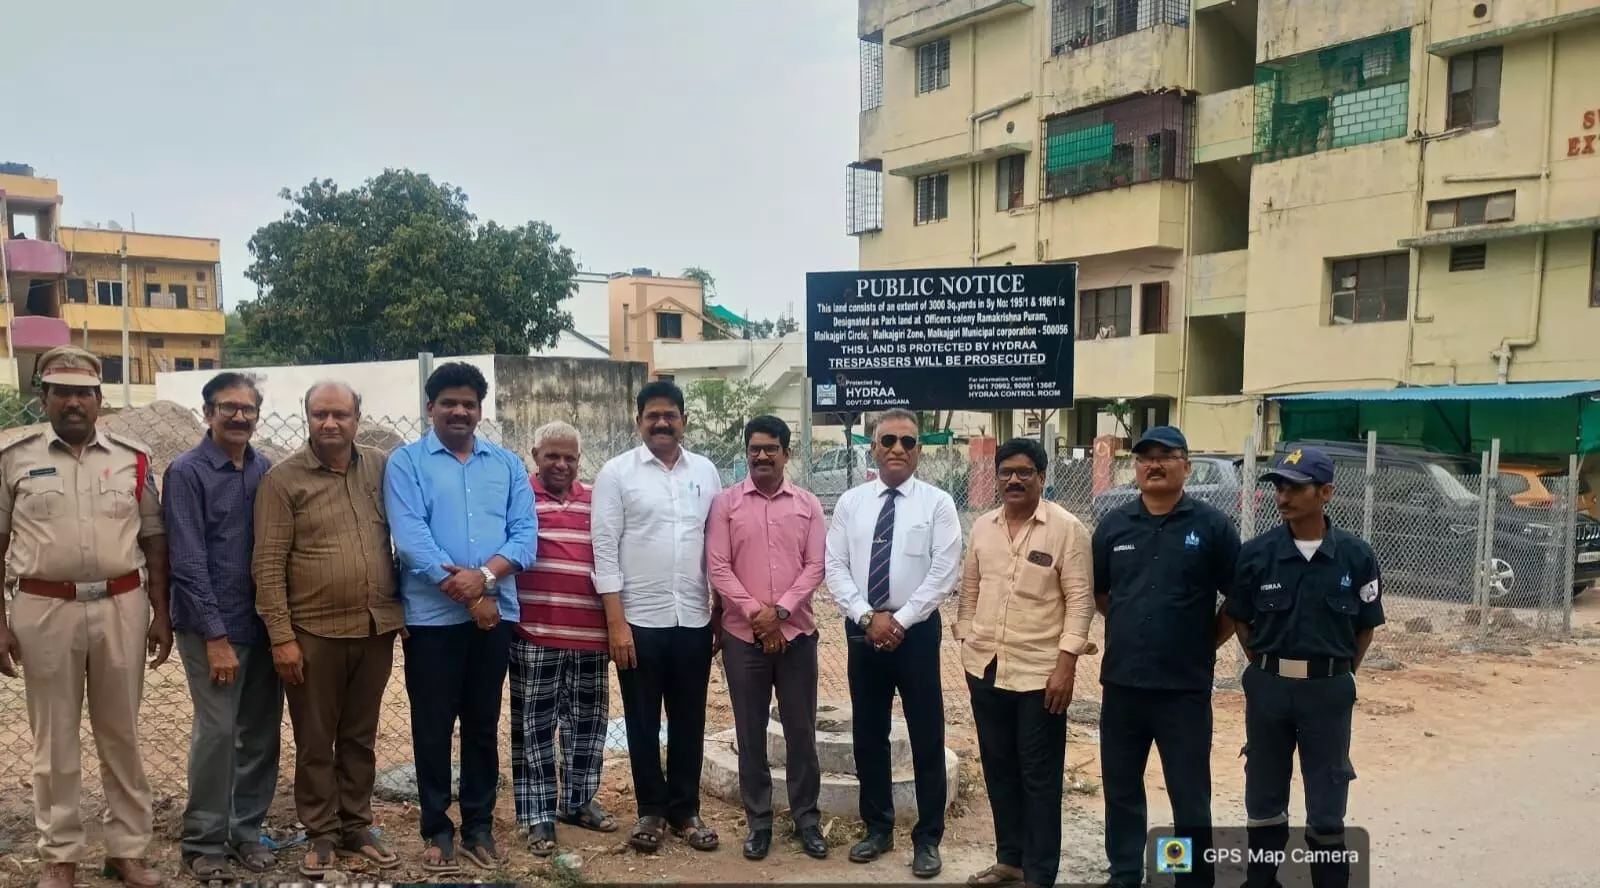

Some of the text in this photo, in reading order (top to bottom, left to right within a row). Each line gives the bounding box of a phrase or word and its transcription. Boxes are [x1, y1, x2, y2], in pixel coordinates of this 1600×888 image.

[1583, 109, 1600, 130] S
[1567, 134, 1600, 157] EX
[857, 274, 1025, 297] PUBLIC NOTICE
[817, 303, 831, 313] This
[833, 302, 847, 313] land
[849, 302, 876, 312] consists
[878, 301, 885, 311] of
[897, 301, 918, 311] extent
[920, 300, 927, 310] of
[929, 300, 945, 310] 3000
[978, 299, 984, 309] in
[986, 298, 995, 311] Sy
[997, 298, 1008, 308] No:
[1010, 297, 1028, 308] 195/1
[1031, 297, 1036, 307] &
[1039, 296, 1057, 307] 196/1
[1058, 296, 1065, 306] is
[833, 311, 1048, 328] Designated as Park land at Officers colony Ramakrishna Puram,
[814, 331, 846, 342] Malkajgiri
[848, 330, 869, 341] Circle,
[873, 329, 905, 341] Malkajgiri
[907, 329, 926, 340] Zone,
[927, 328, 960, 340] Malkajgiri
[962, 327, 995, 339] Municipal
[997, 325, 1036, 338] corporation
[1042, 324, 1068, 335] 500056
[841, 340, 1037, 355] THIS LAND IS PROTECTED BY HYDRAA
[829, 354, 1046, 369] TRESPASSERS WILL BE PROSECUTED
[846, 387, 896, 398] HYDRAA
